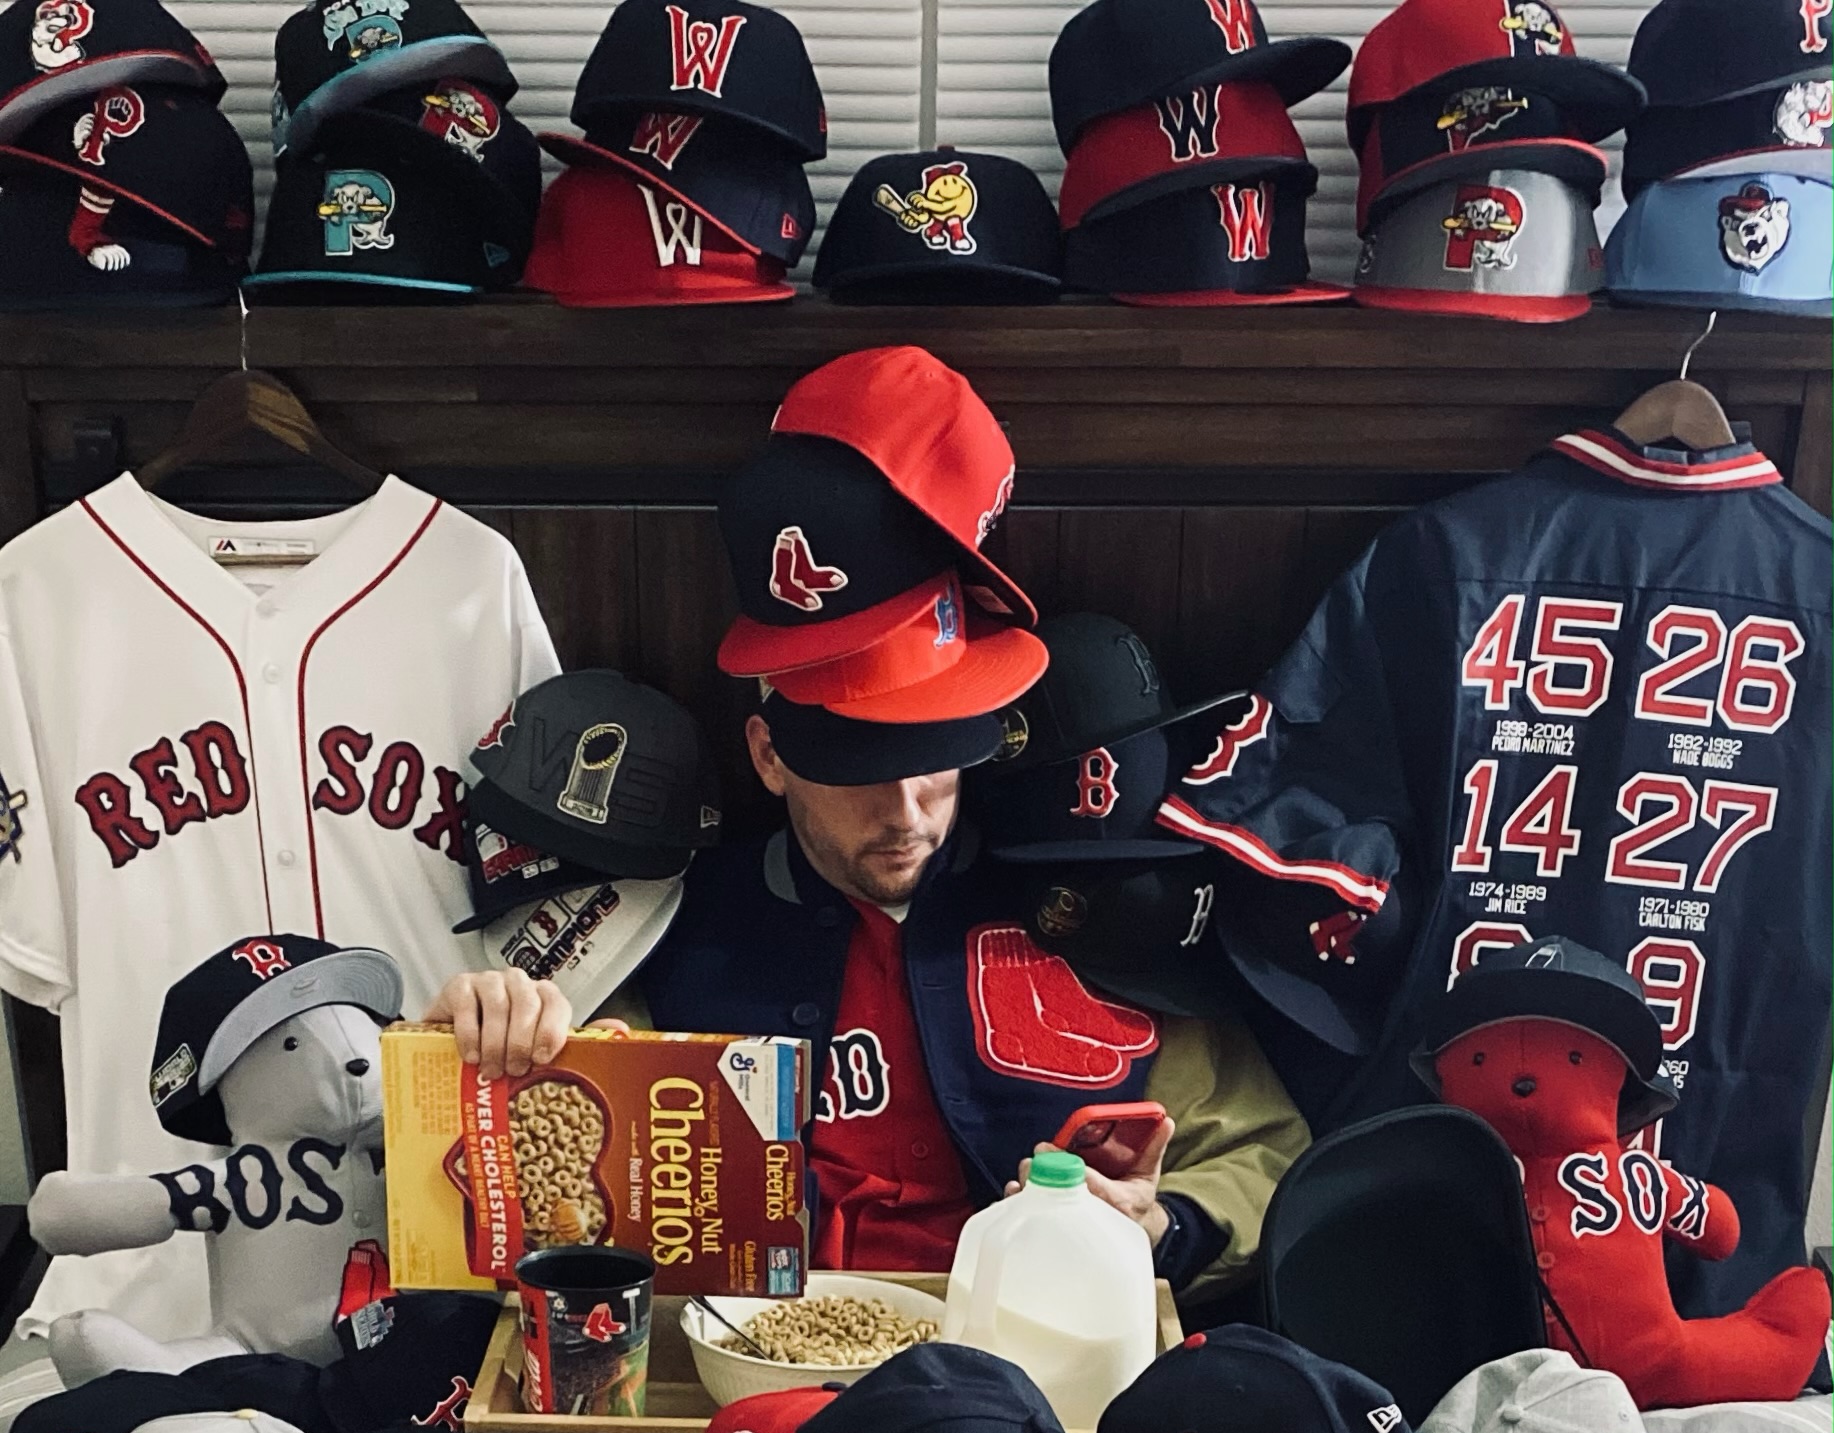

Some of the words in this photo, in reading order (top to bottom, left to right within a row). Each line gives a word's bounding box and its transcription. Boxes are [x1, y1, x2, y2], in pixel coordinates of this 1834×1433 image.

[666, 4, 747, 98] W
[1209, 181, 1275, 263] W
[1462, 594, 1623, 717] 45
[1634, 604, 1805, 734] 26
[1491, 735, 1521, 752] PEDRO
[1521, 737, 1575, 756] MARTINEZ
[1495, 719, 1574, 741] 1998-2004
[1667, 733, 1742, 756] 1982-1992
[1672, 748, 1700, 766] WADE
[1701, 751, 1734, 770] BOGGS
[74, 720, 252, 869] RED
[313, 725, 471, 867] SOX
[1069, 746, 1121, 819] B
[1451, 759, 1582, 877] 14
[1604, 771, 1779, 894] 27
[1468, 881, 1547, 902] 1974-1989
[1484, 897, 1503, 913] JIM
[1503, 898, 1528, 915] RICE
[1638, 896, 1710, 918] 1971-1980
[1638, 911, 1682, 930] CARLTON
[1683, 915, 1706, 932] FISK
[496, 1135, 511, 1162] CAN
[503, 1163, 517, 1200] HELP
[629, 1157, 643, 1183] Real
[649, 1076, 706, 1266] Cheerios
[694, 1147, 723, 1213] Honey
[765, 1144, 789, 1222] Cheerios
[480, 1136, 508, 1271] CHOLESTEROL
[627, 1185, 644, 1223] Honey
[1557, 1149, 1709, 1240] SOX
[701, 1217, 724, 1256] Nut
